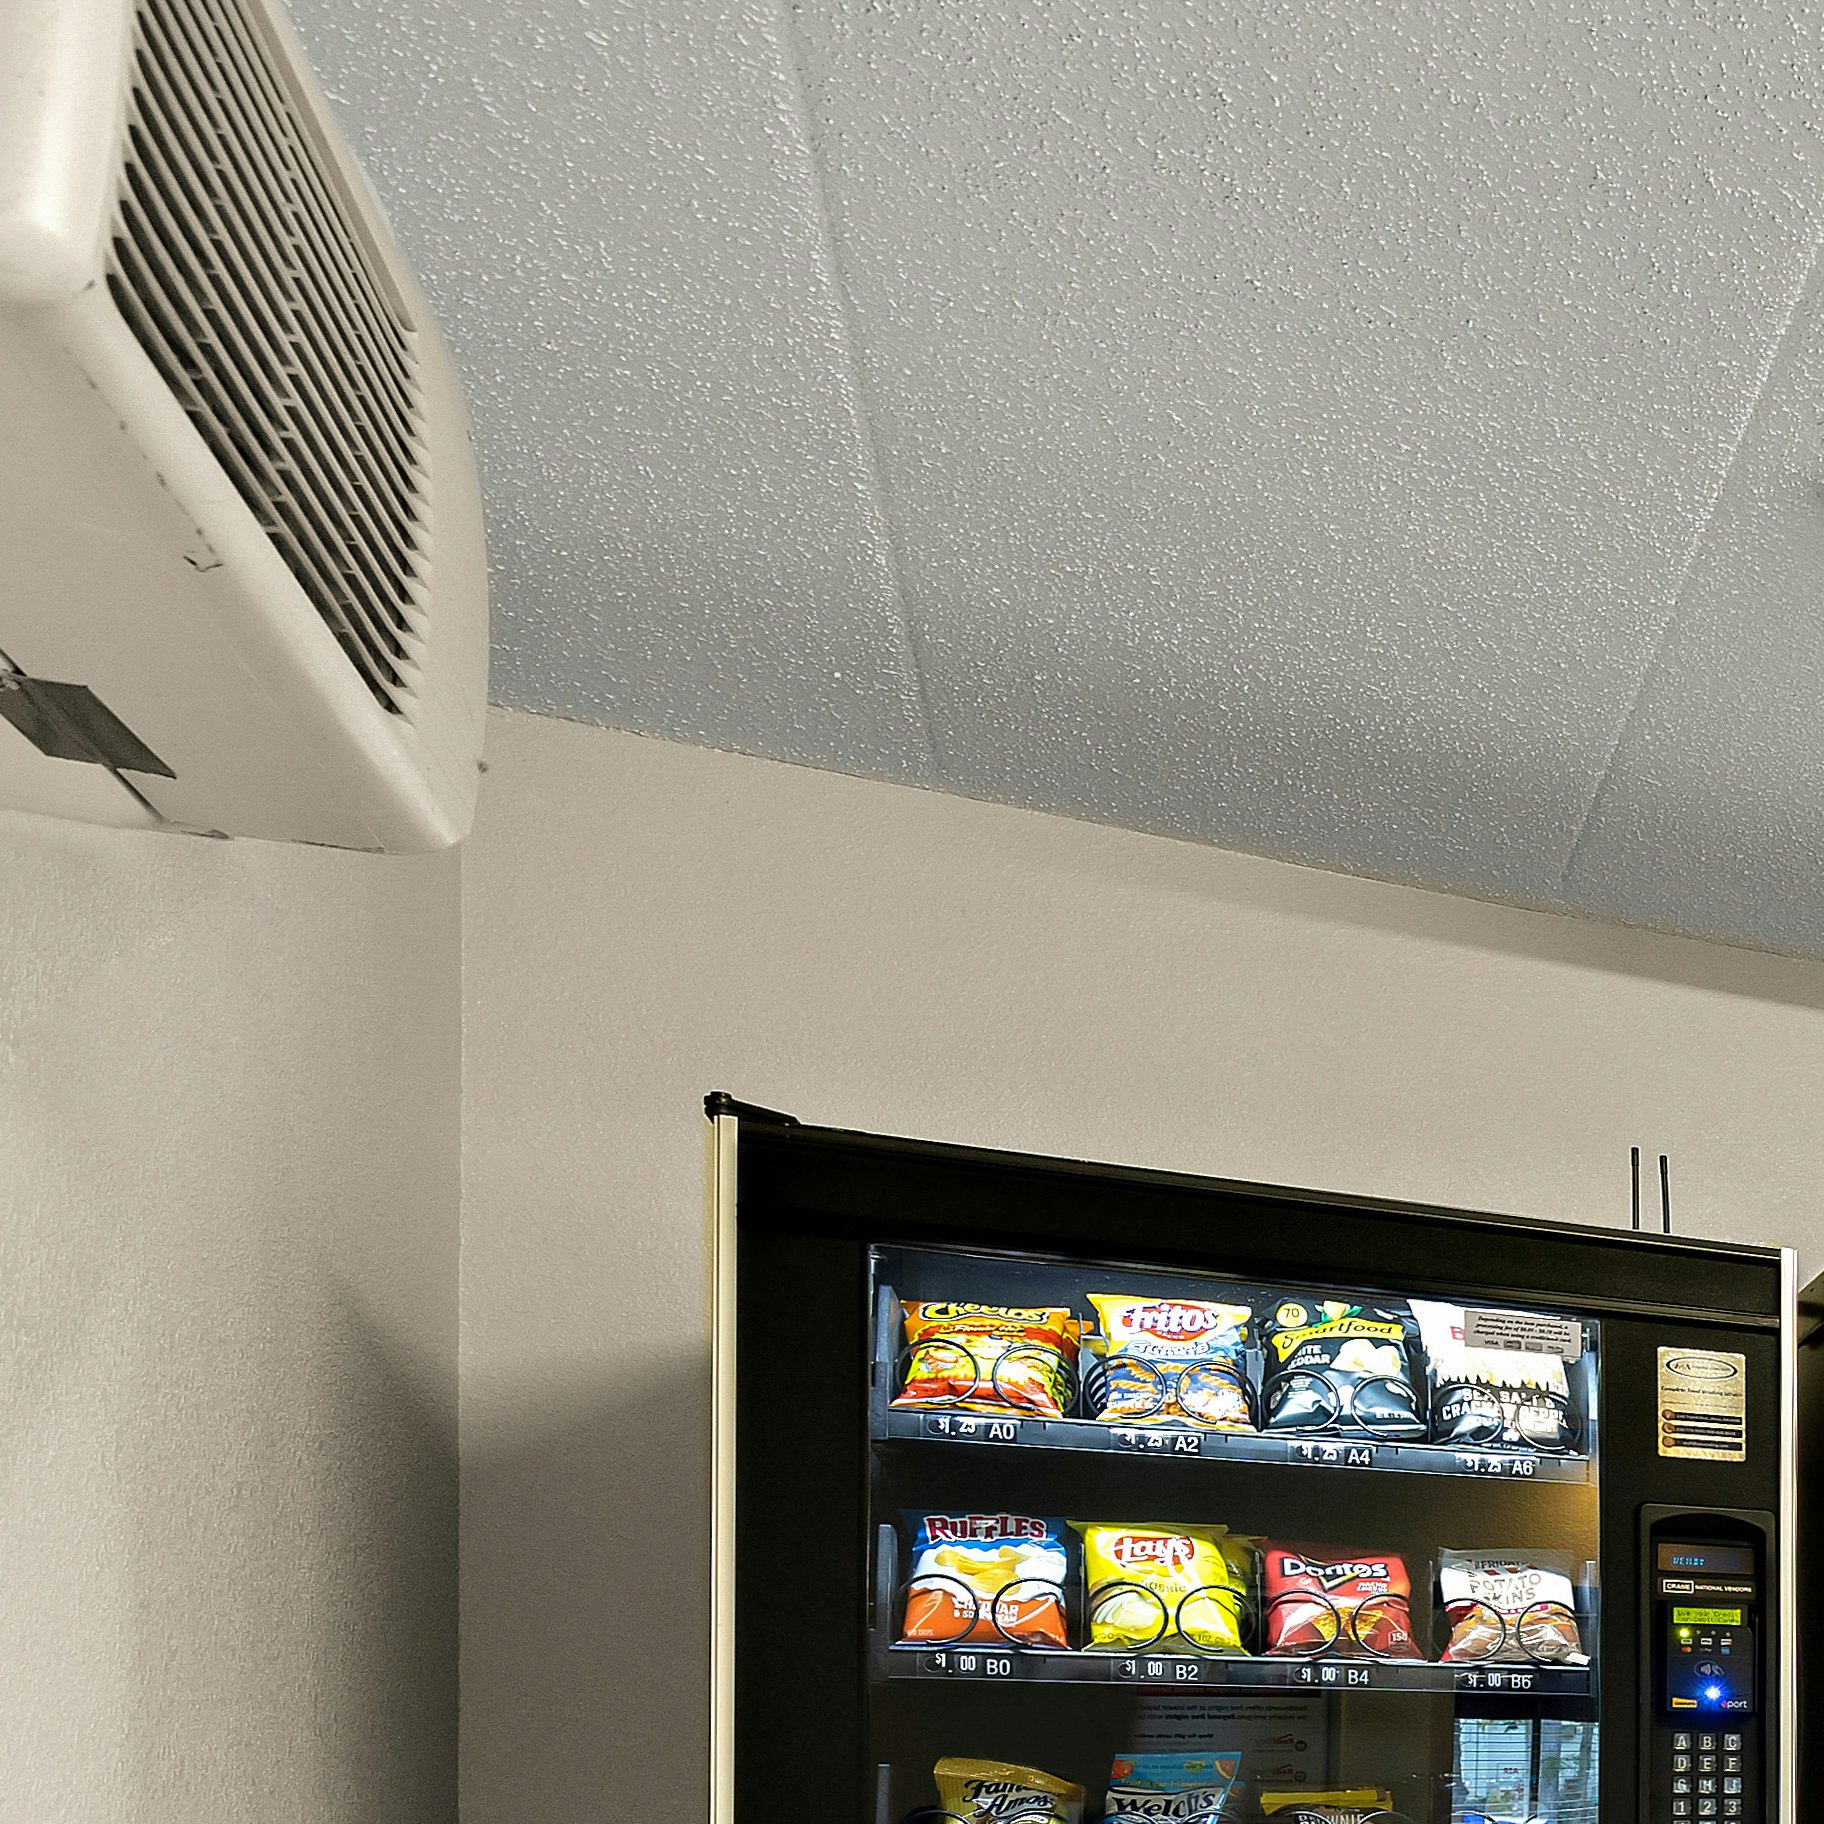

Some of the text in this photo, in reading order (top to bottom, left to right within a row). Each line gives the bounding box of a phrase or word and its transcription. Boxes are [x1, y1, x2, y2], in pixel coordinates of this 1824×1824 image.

[1119, 1303, 1219, 1334] Fritos
[1283, 1307, 1300, 1318] 70
[988, 1424, 1015, 1440] A0
[1174, 1436, 1200, 1452] A2
[1347, 1448, 1371, 1465] A4
[1511, 1460, 1534, 1475] A6
[924, 1515, 1047, 1541] RUFFLES
[1122, 1536, 1193, 1566] Lay's
[1282, 1558, 1389, 1579] Doritos
[986, 1659, 1011, 1675] B0
[1176, 1665, 1199, 1681] B2
[1347, 1669, 1370, 1685] B4
[1111, 1791, 1216, 1819] Welch's
